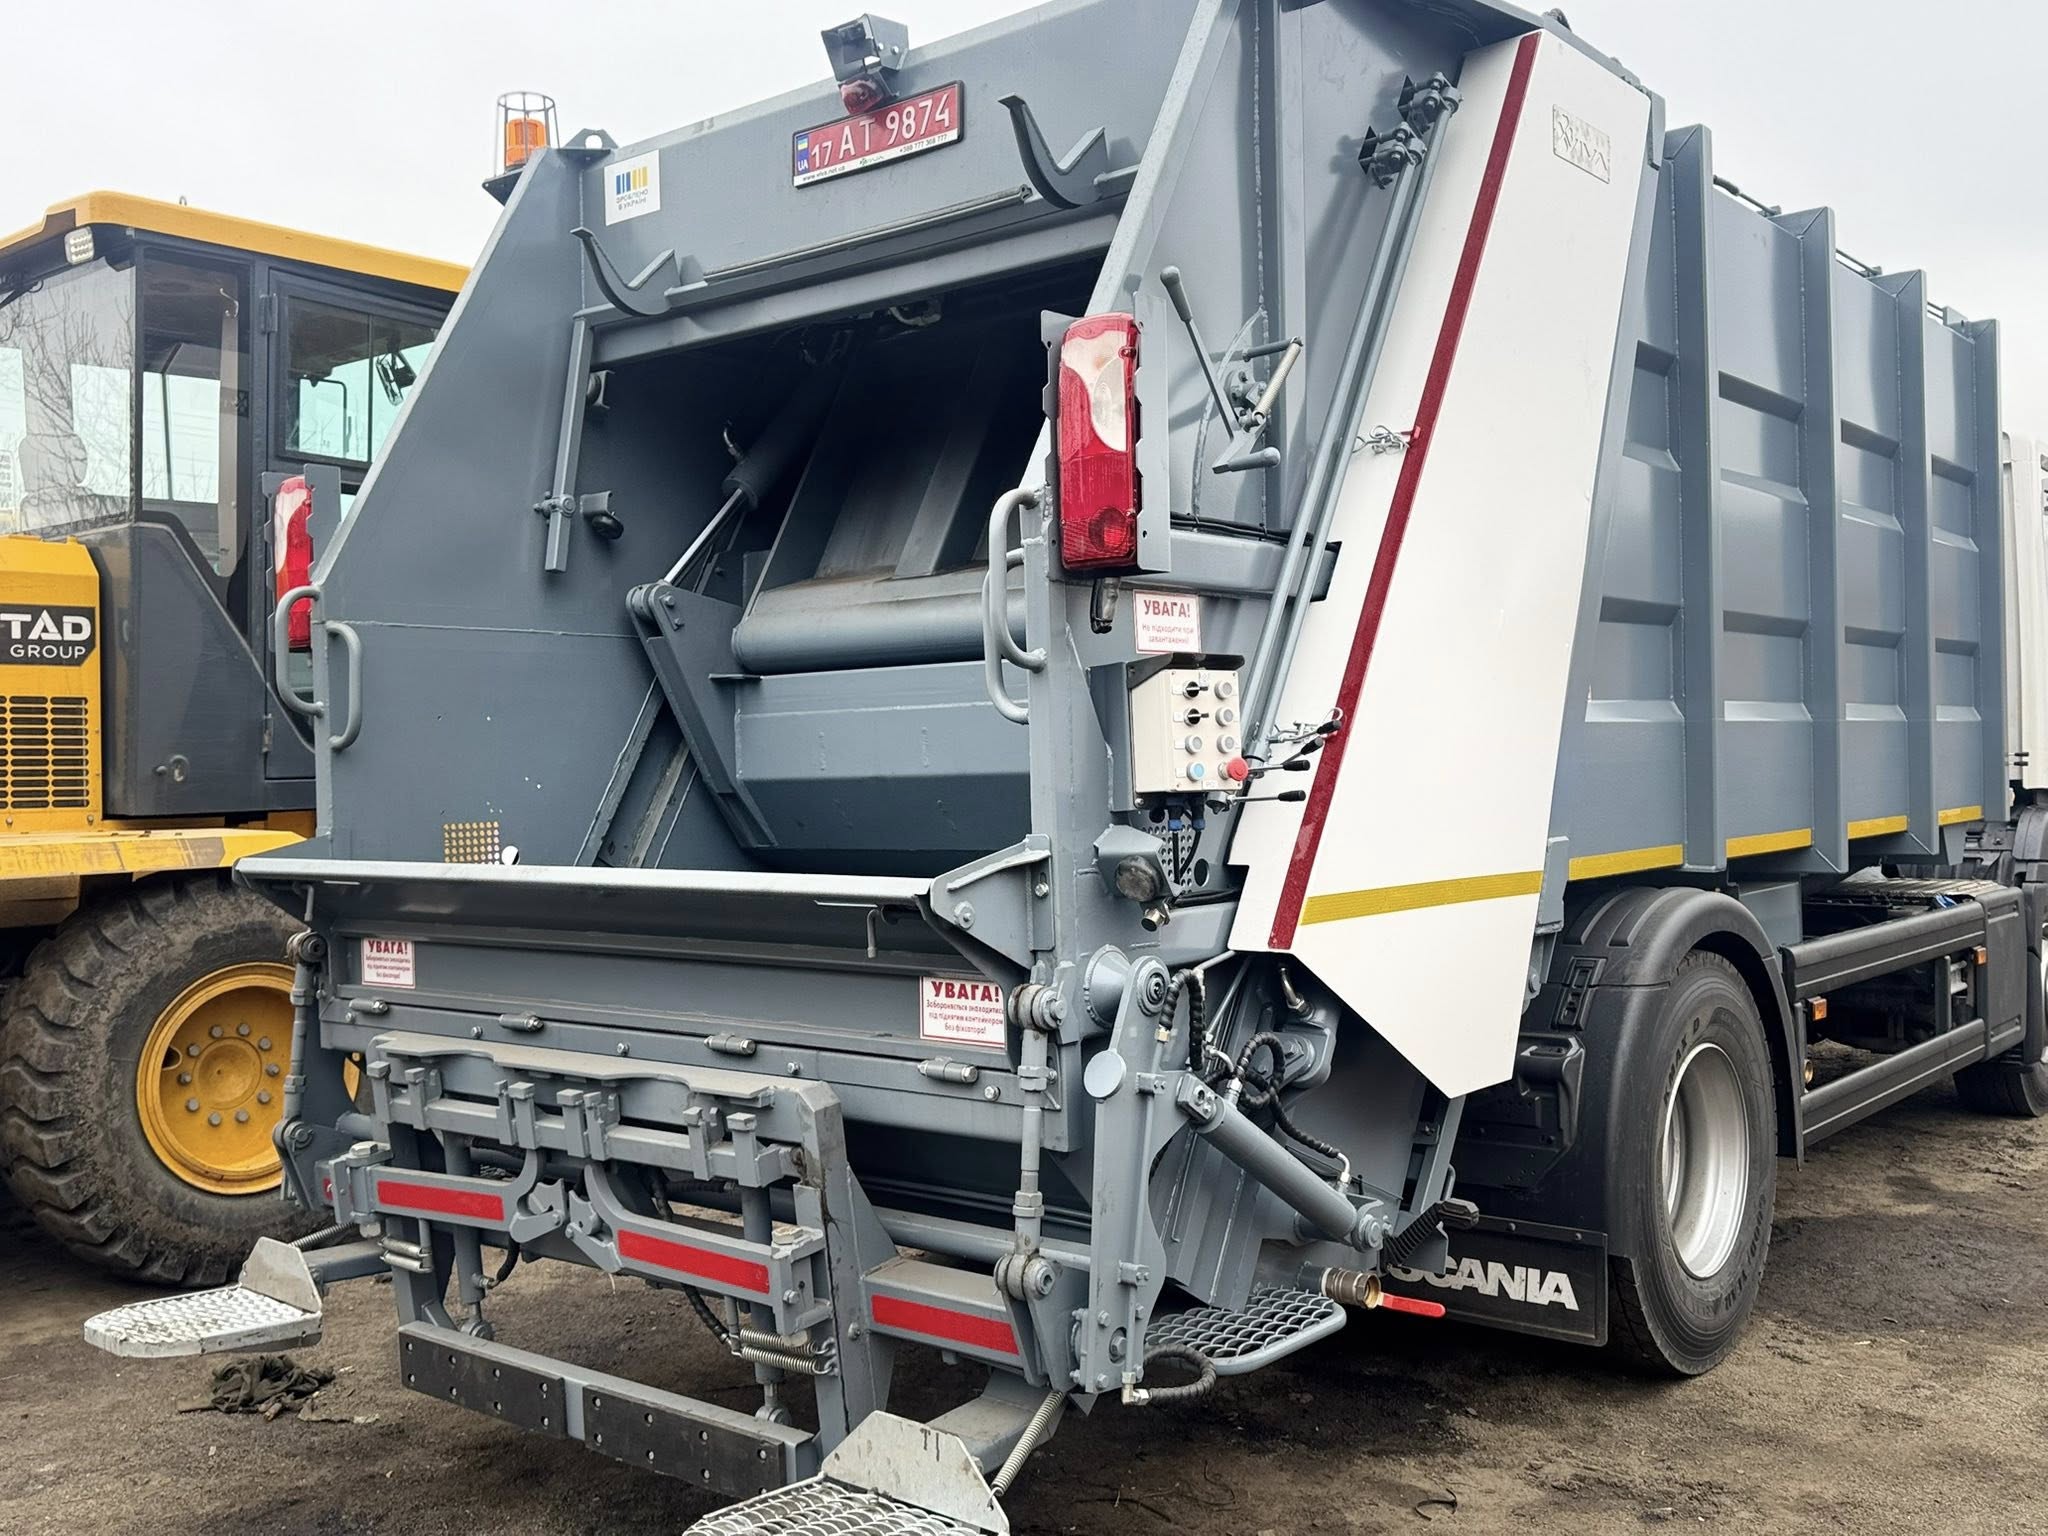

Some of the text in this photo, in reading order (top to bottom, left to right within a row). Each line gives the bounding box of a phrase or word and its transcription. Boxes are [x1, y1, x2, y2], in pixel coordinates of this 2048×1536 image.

[811, 93, 949, 169] 17 AT 9874
[797, 159, 809, 172] UA
[1143, 599, 1190, 618] УВАГА!
[0, 609, 92, 641] TAD
[10, 644, 86, 659] GROUP
[367, 940, 408, 955] УВАГА!
[931, 981, 1000, 1003] УВАГА!
[1692, 1016, 1700, 1034] D
